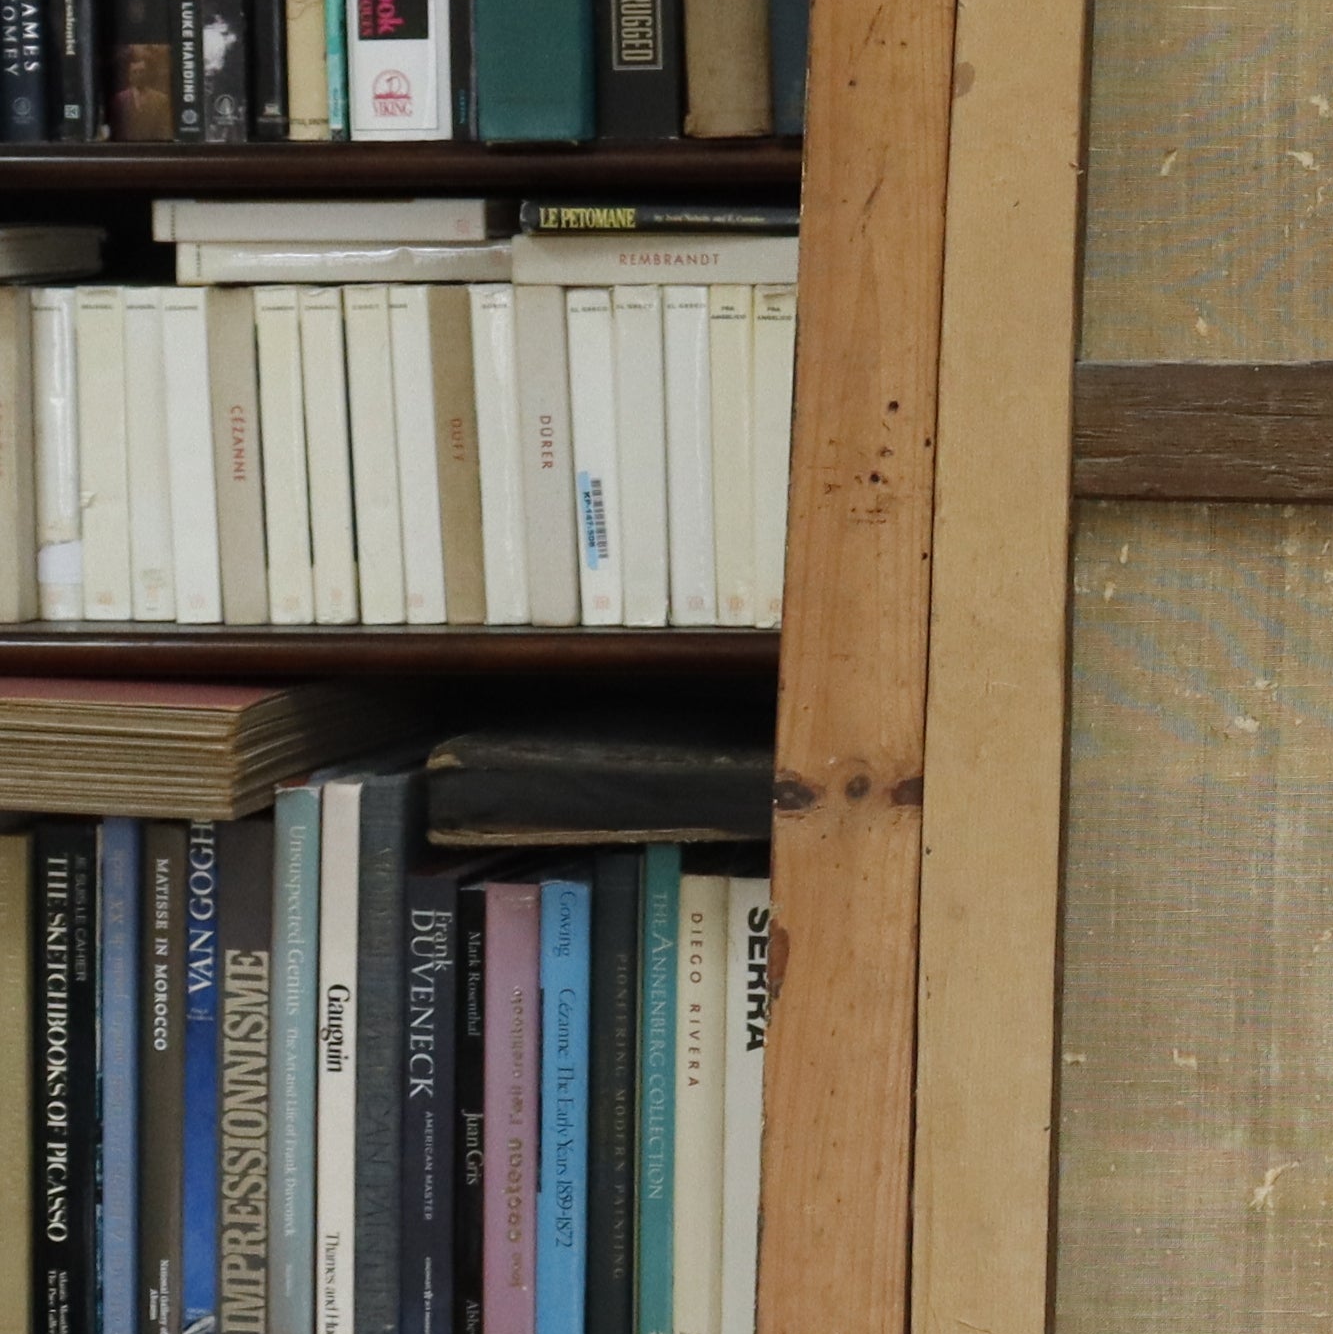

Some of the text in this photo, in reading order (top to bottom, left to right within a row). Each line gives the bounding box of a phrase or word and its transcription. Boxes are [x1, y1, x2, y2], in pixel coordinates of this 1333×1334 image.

[181, 2, 195, 103] LUKE HARDING
[374, 102, 413, 117] VIKING
[540, 208, 636, 229] LE PETOMANE
[619, 253, 719, 266] REMBRANDT
[230, 405, 247, 482] CÉZANNE
[451, 418, 465, 461] DUFY
[188, 823, 215, 994] VAN GOGH
[285, 824, 307, 946] Unsuspected
[553, 891, 577, 957] Gowing
[75, 925, 88, 982] CAHIER
[153, 858, 170, 1051] MATISSE IN MOROCCO
[286, 948, 305, 1016] Genius
[434, 911, 453, 971] Frank
[467, 931, 481, 1036] Mark Rosenthal
[746, 906, 770, 1052] SERRA
[287, 1028, 298, 1050] The
[321, 983, 351, 1073] Gauguin
[409, 909, 435, 1098] DUVENECK
[647, 892, 674, 1199] THE ANNENBERG COLLECTION
[688, 913, 703, 1088] DIEGO RIVERA
[46, 857, 68, 1244] THE SKETCHBOOKS OF PICASSO
[555, 988, 577, 1182] Cézanne The Early Years
[284, 1138, 298, 1175] Frank
[462, 1109, 484, 1185] Juan Gris
[613, 954, 628, 1280] PIONEERING MODERN PAINTING
[423, 1111, 434, 1220] AMERICAN MASTER
[504, 1137, 524, 1243] cocteau
[325, 1232, 339, 1284] Thames
[325, 1286, 339, 1311] and
